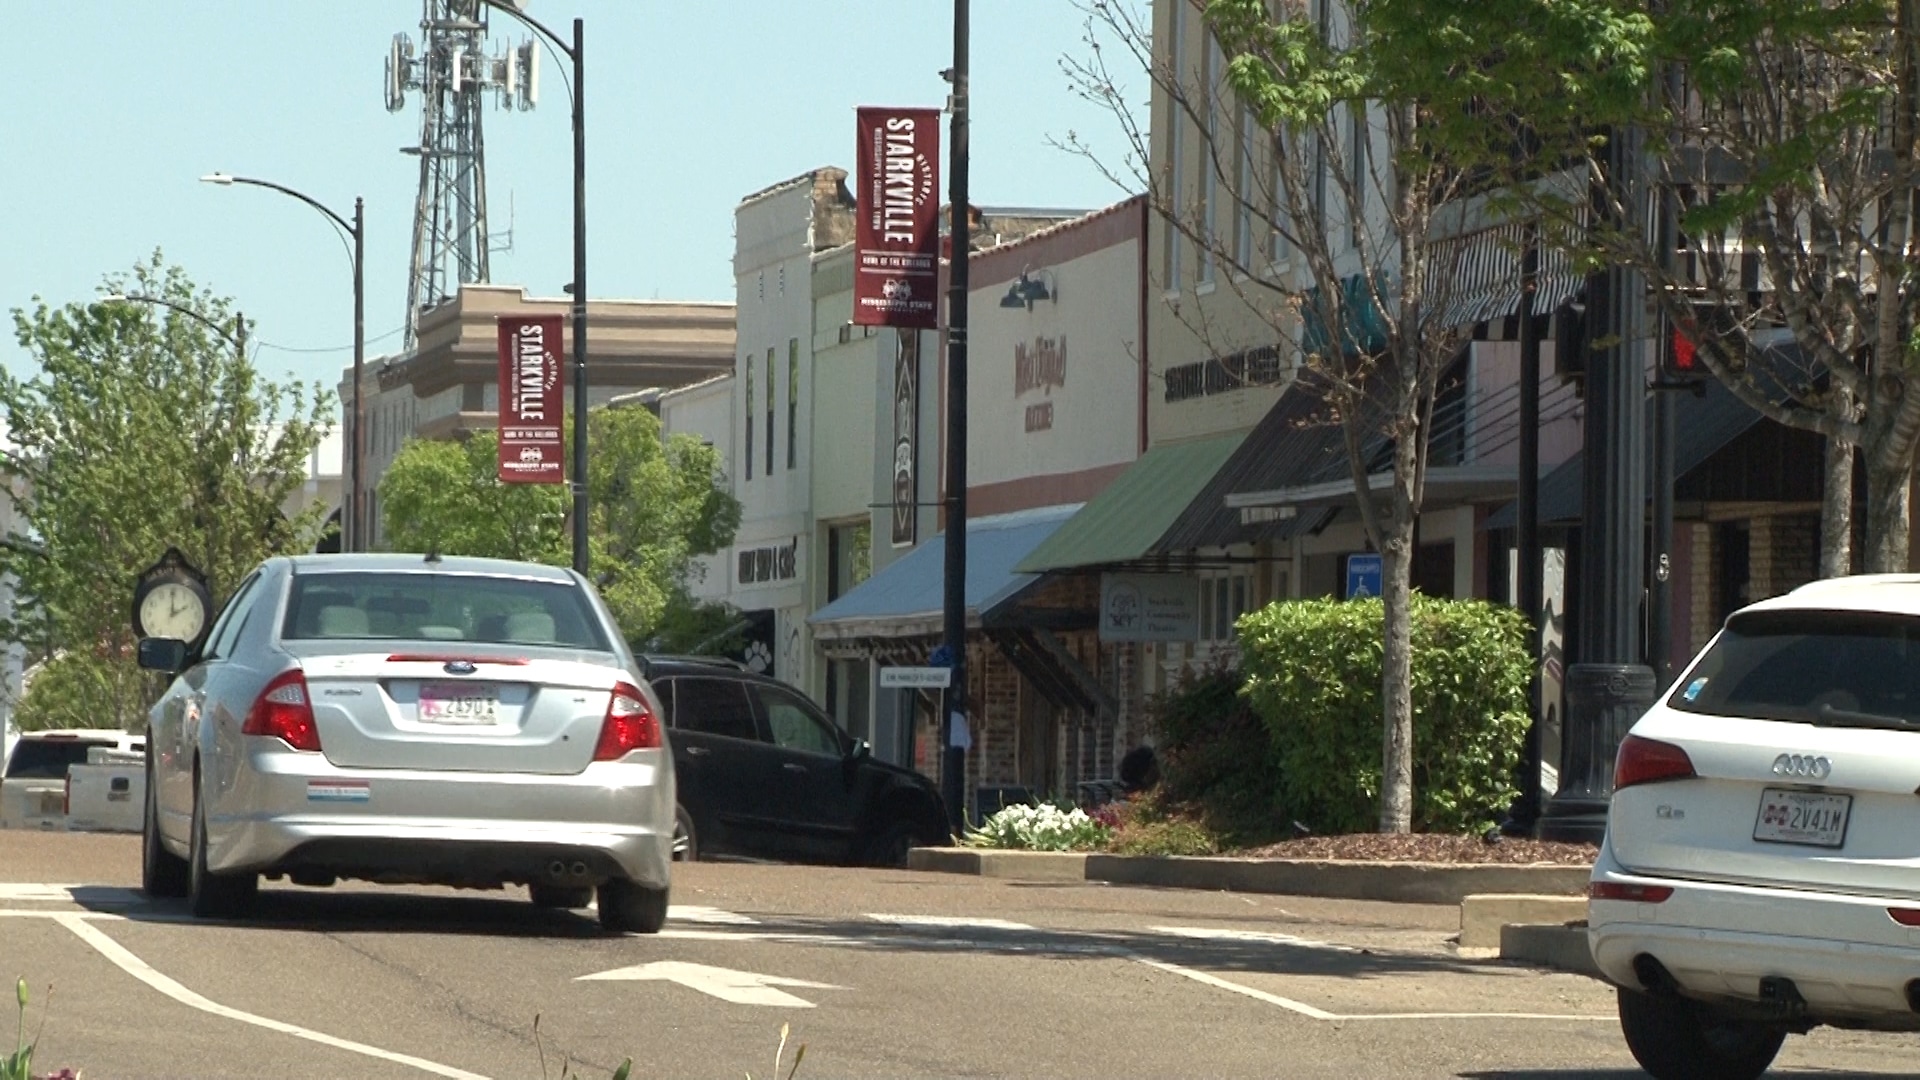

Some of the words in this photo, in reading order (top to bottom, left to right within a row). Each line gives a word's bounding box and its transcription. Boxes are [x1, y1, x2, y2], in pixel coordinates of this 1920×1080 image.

[884, 117, 915, 244] STARKVILLE
[862, 255, 879, 266] HOME
[889, 256, 900, 266] THE
[860, 297, 908, 307] MISSISSIPPI
[908, 300, 933, 310] STATE
[520, 325, 544, 420] STARKVILLE
[1790, 806, 1842, 832] 2V41M
